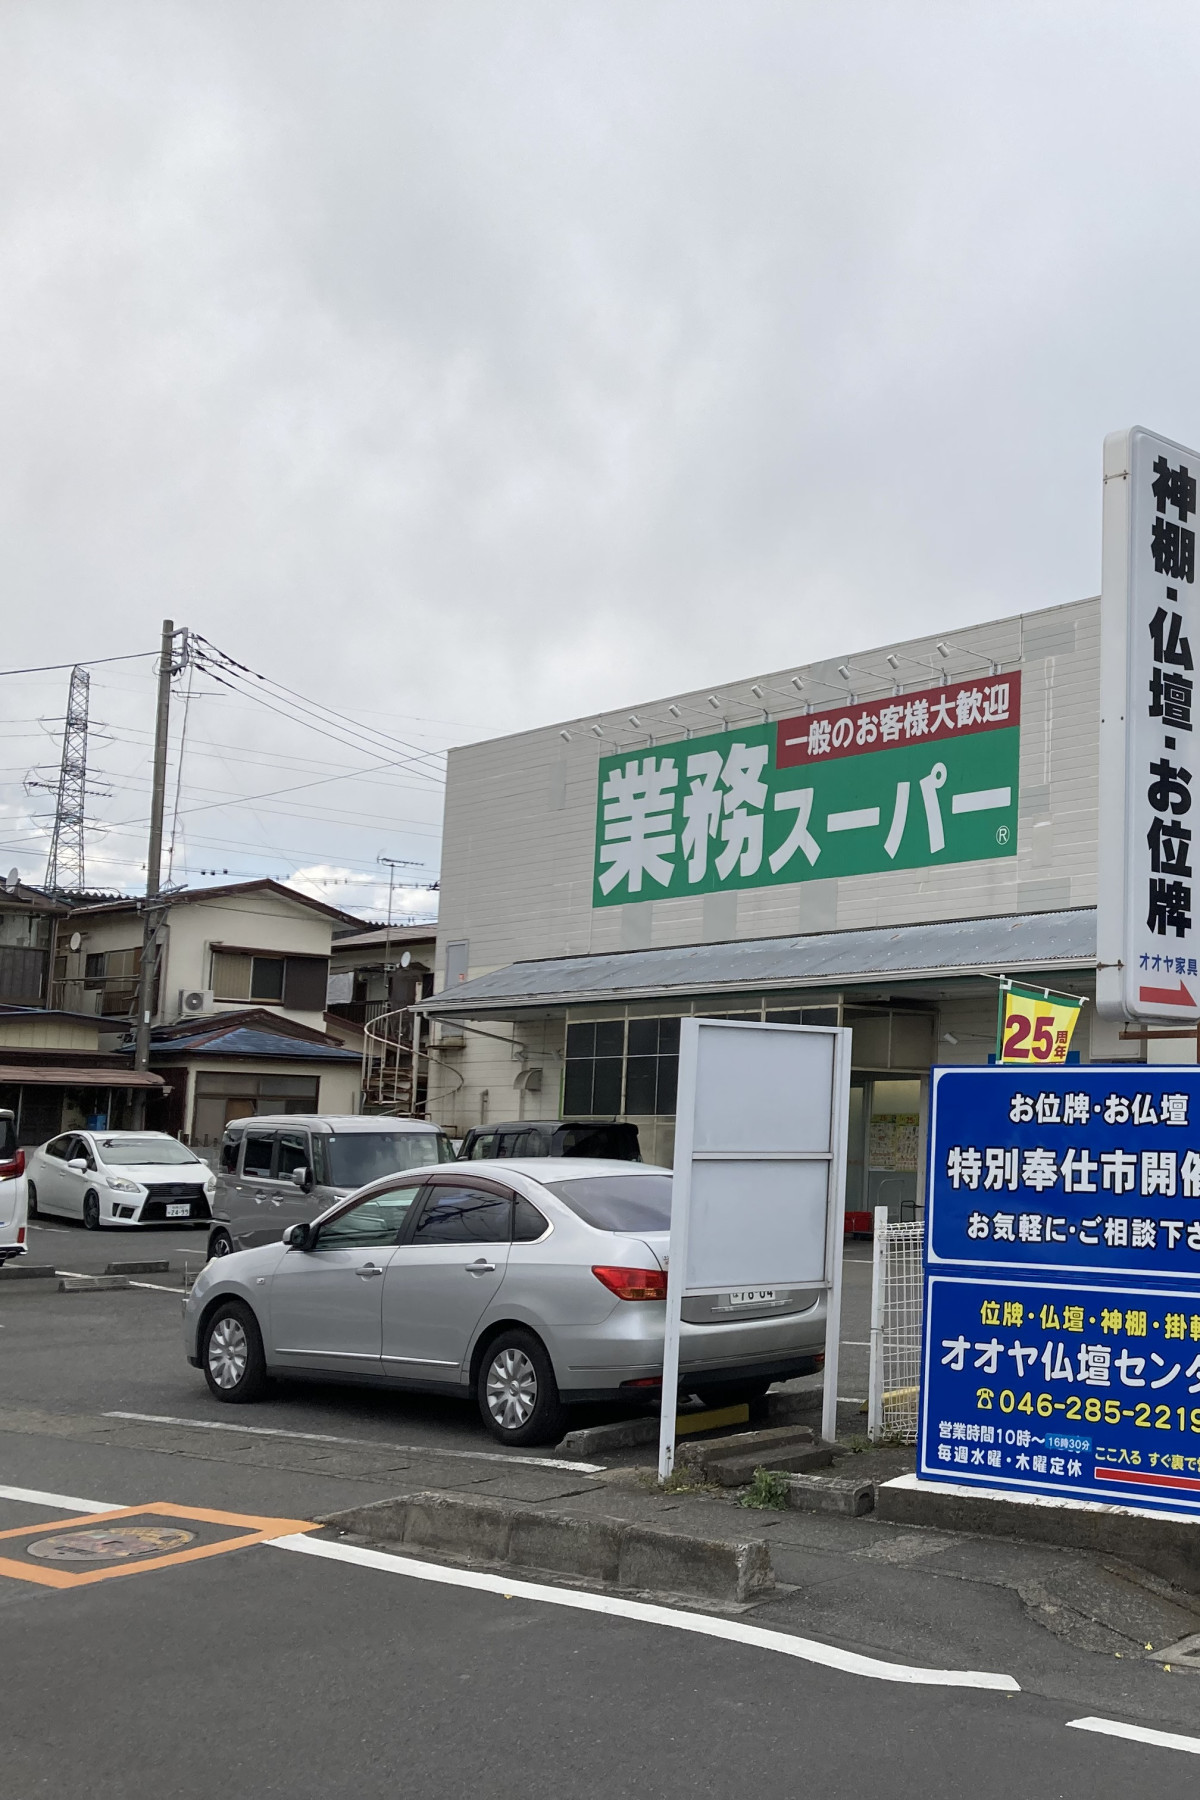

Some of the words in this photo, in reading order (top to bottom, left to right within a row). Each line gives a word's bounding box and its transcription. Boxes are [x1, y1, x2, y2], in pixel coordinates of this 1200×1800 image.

[785, 683, 1010, 756] 一般のお客様大歓迎
[1147, 455, 1197, 938] 神棚・仏壇・お位牌
[598, 743, 1011, 896] 業務スーパー
[1140, 952, 1198, 977] オオヤ家具
[1009, 1093, 1188, 1126] お位牌・お仏壇
[938, 1444, 1082, 1477] 毎週水曜・木曜定休
